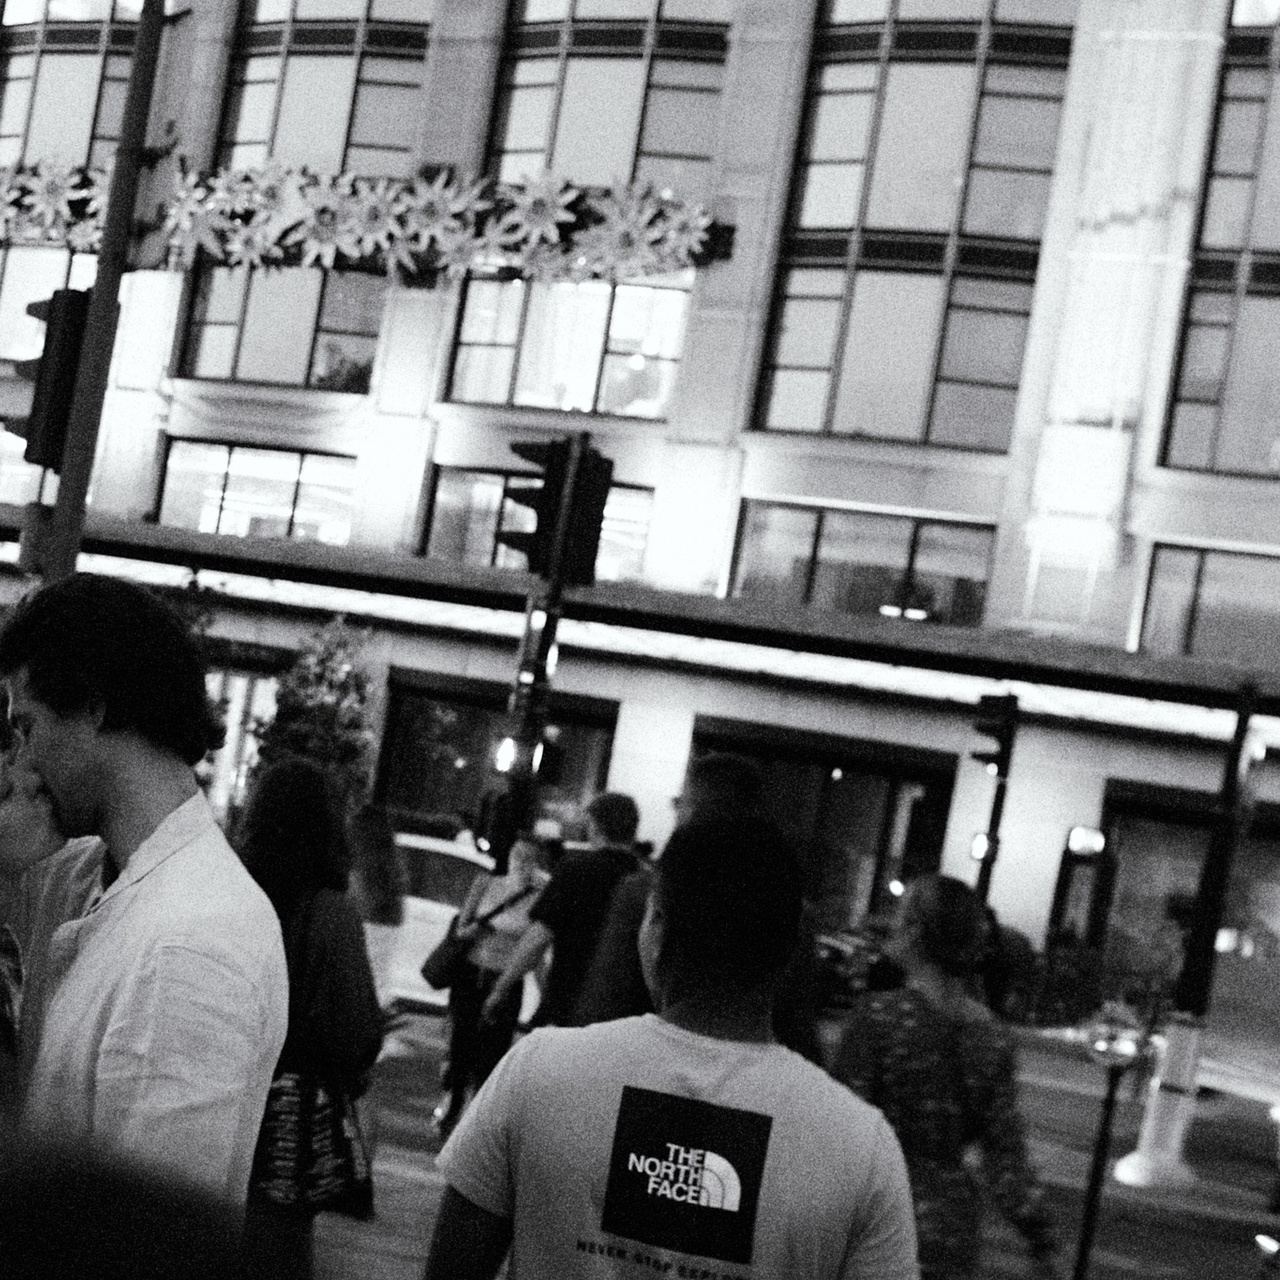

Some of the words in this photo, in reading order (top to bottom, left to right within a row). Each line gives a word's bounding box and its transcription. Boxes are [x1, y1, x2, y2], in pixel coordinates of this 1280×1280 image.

[628, 1152, 703, 1186] NORTH
[666, 1142, 704, 1168] THE
[648, 1176, 700, 1205] FACE
